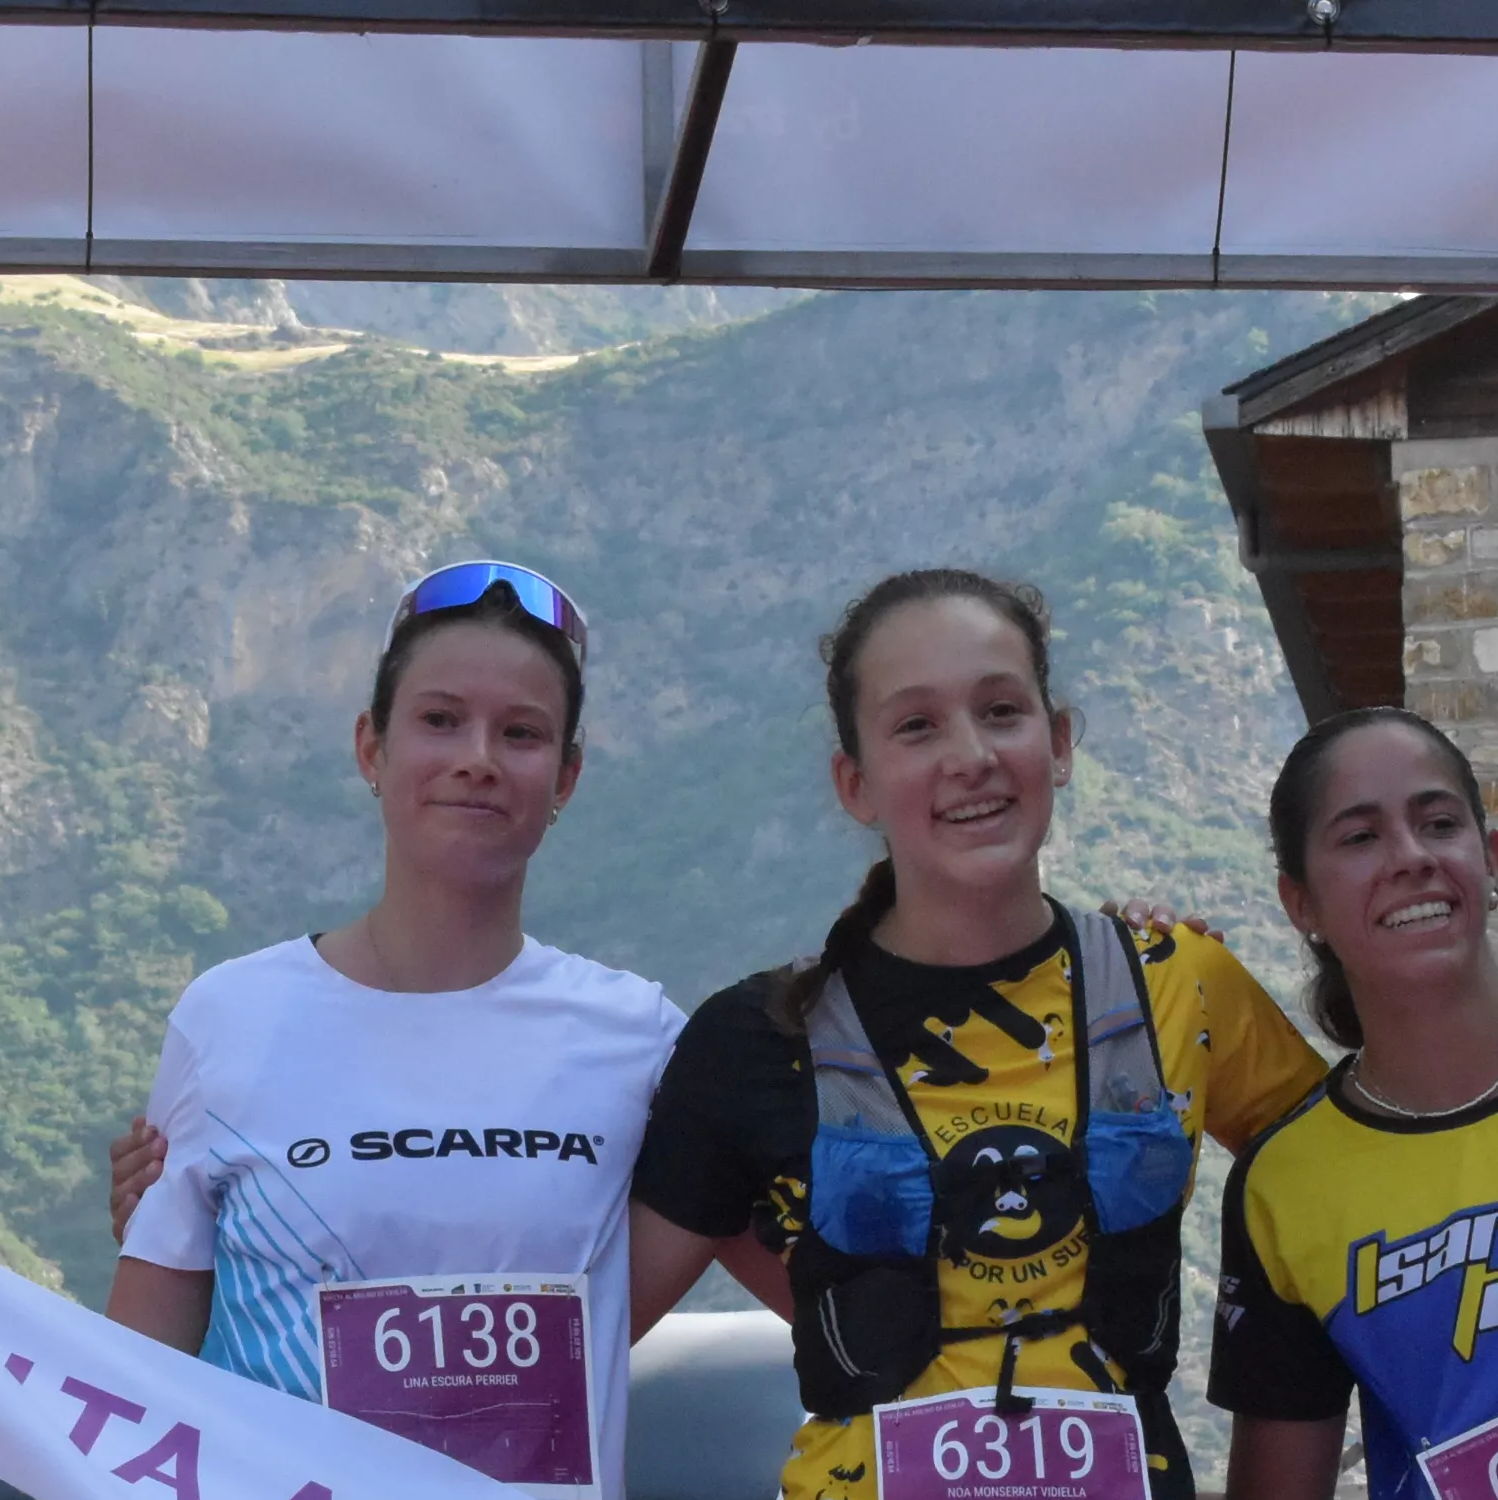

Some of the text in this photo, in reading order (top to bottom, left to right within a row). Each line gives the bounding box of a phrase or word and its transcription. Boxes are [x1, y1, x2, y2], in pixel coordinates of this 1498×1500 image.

[935, 1103, 1069, 1144] ESCUELA
[351, 1128, 599, 1165] SCARPA
[1011, 1259, 1047, 1283] UN
[1052, 1229, 1089, 1268] SUE
[374, 1302, 540, 1373] 6138
[403, 1374, 519, 1389] LINA ESCURA PERRIER
[932, 1414, 1094, 1480] 6319
[947, 1486, 1087, 1498] NOA MONSERRAT VIDIELLA
